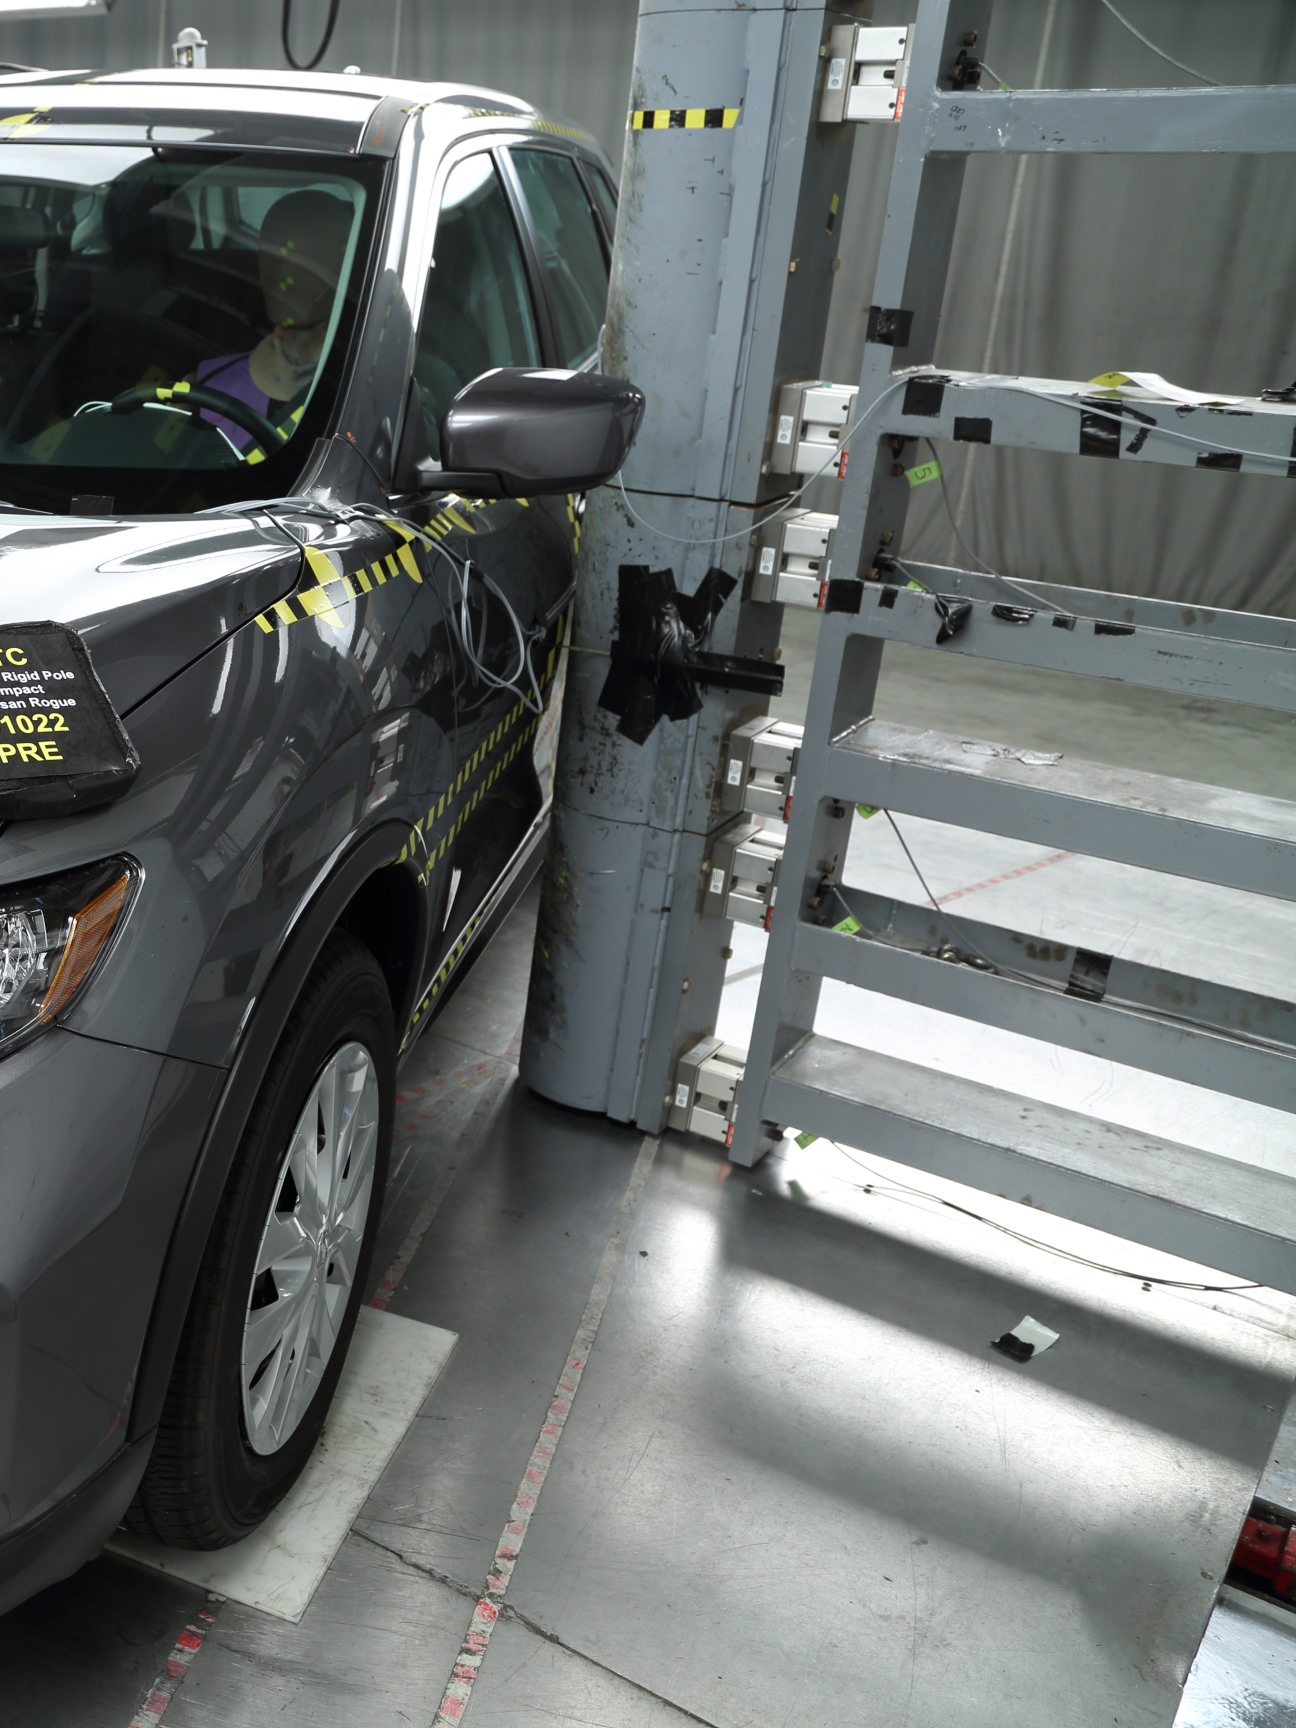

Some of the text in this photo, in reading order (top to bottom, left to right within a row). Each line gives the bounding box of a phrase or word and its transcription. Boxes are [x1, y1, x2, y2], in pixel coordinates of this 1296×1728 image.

[914, 467, 933, 480] 5
[0, 670, 41, 684] Rigid
[42, 669, 75, 682] Pole
[29, 696, 77, 709] Rogue
